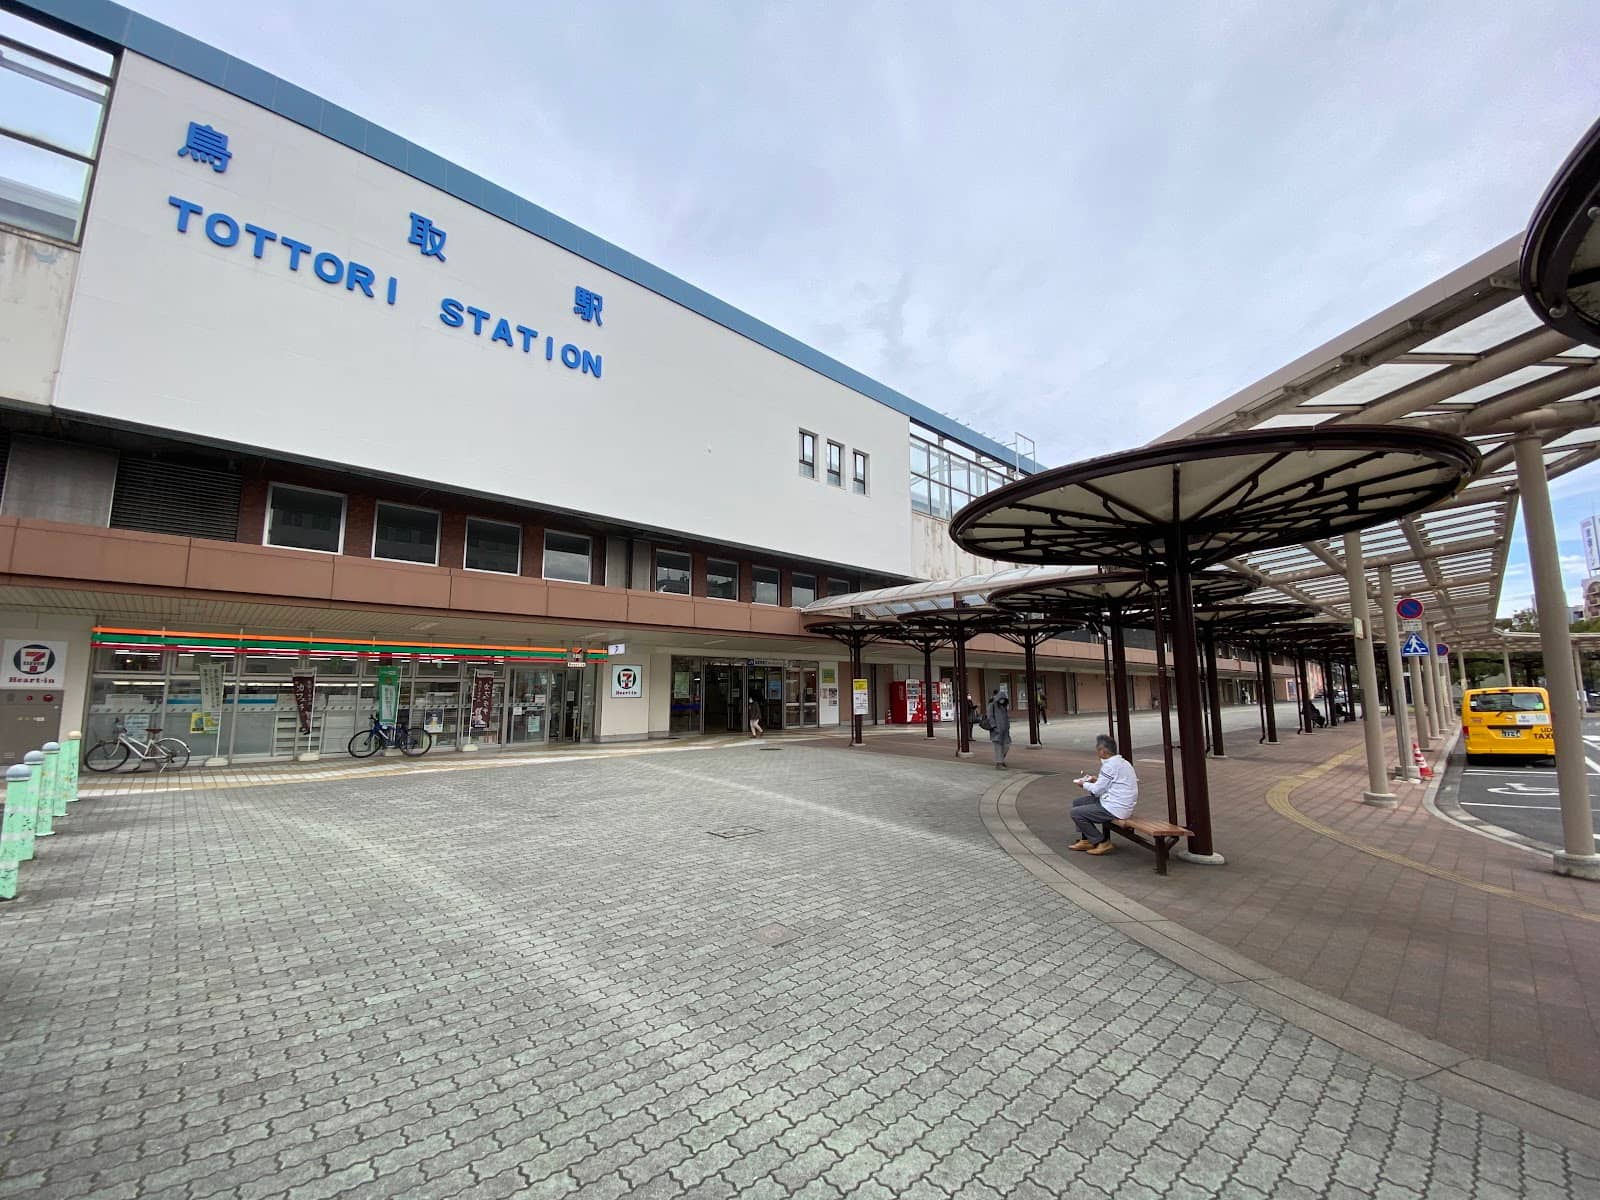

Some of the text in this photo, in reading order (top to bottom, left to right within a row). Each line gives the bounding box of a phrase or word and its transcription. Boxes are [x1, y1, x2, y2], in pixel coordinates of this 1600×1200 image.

[178, 121, 603, 327] 鳥 取 駅
[168, 196, 603, 378] TOTTORI STATION
[8, 676, 55, 684] Heart-in
[25, 651, 46, 673] 7
